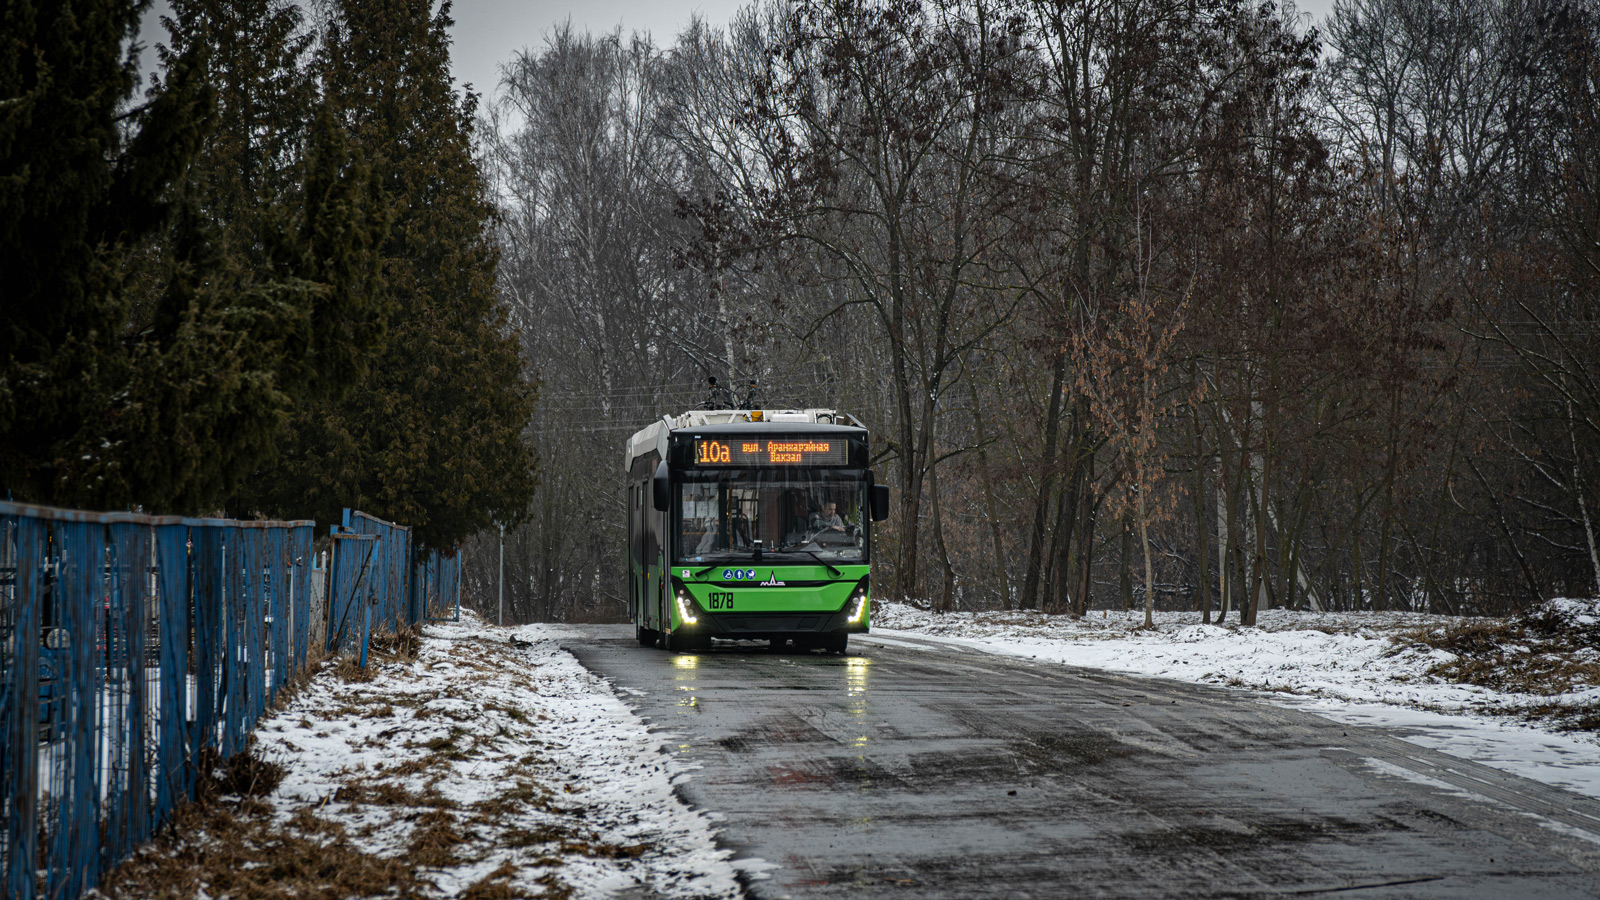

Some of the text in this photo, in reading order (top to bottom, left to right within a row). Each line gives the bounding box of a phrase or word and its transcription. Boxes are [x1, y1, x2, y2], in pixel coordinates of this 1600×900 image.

[742, 443, 763, 452] вул.
[770, 451, 802, 462] Вакзал
[708, 592, 734, 609] 1878
